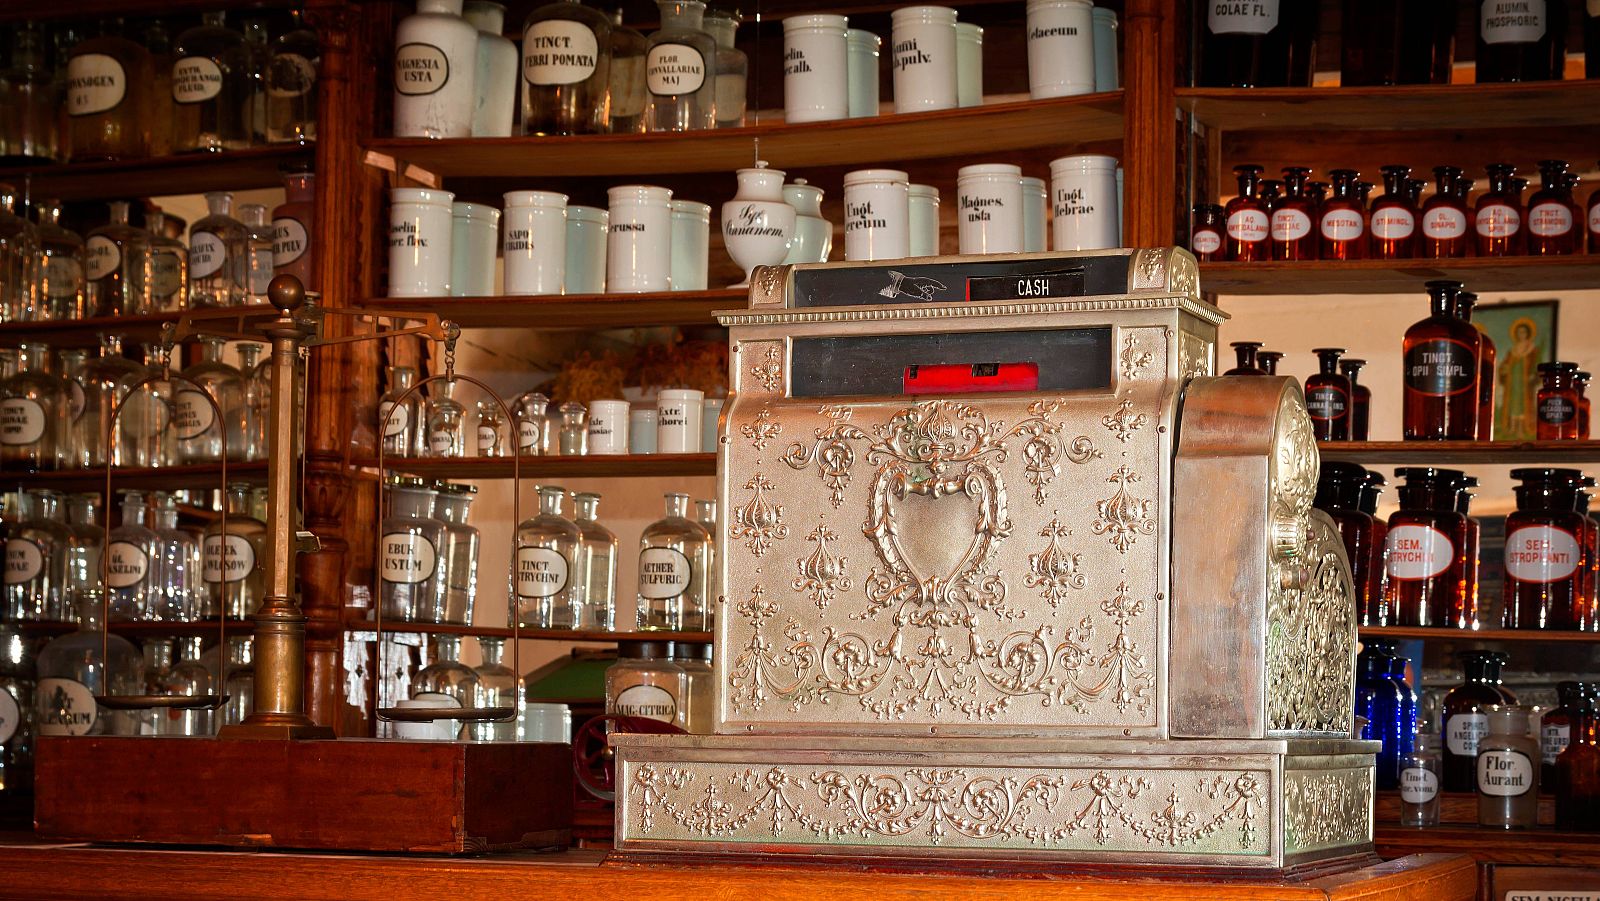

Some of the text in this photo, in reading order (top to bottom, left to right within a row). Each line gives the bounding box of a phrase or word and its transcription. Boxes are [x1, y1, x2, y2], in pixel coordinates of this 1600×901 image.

[1214, 3, 1270, 17] COLAE FL.
[552, 53, 594, 67] POMATA
[404, 71, 432, 82] USTA
[967, 208, 992, 222] usta
[1017, 278, 1049, 296] CASH
[1422, 352, 1455, 364] TINCT.
[1412, 365, 1429, 377] OPII
[1398, 538, 1423, 550] SEM.
